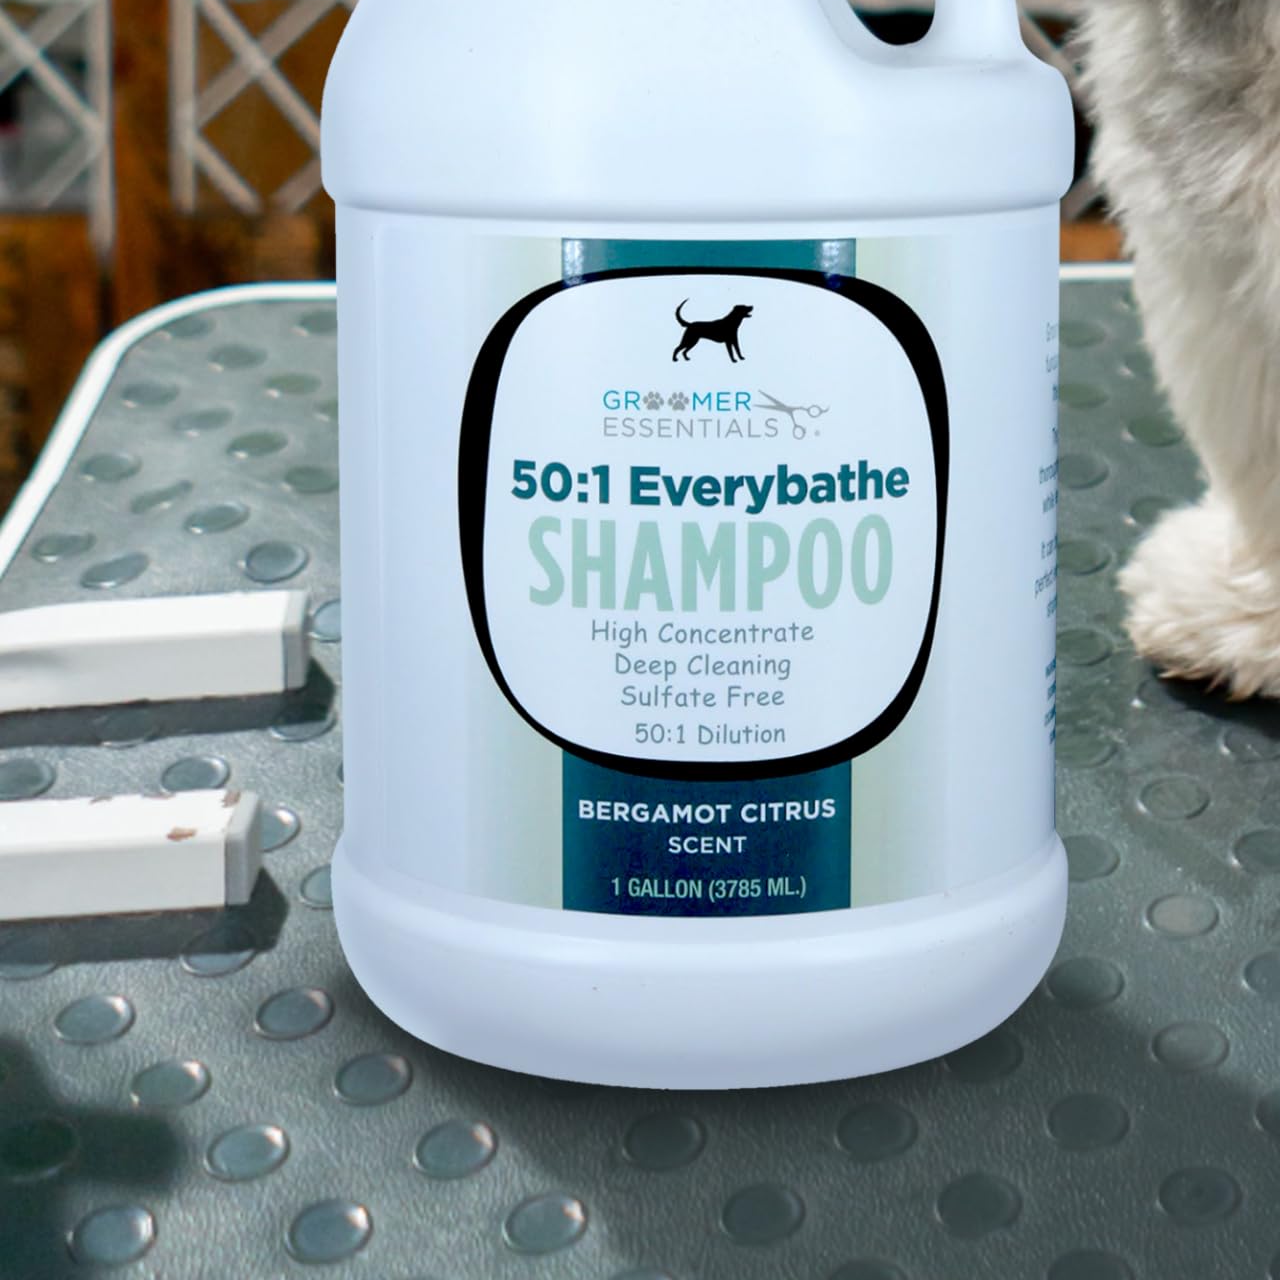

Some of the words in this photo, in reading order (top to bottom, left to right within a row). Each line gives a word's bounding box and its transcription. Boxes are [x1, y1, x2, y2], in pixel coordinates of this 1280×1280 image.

[603, 416, 779, 438] ESSENTIALS
[511, 459, 610, 505] 50:1
[630, 460, 910, 515] Everybathe
[528, 514, 894, 612] SHAMPOO
[591, 620, 648, 649] High
[658, 622, 815, 645] Concentrate
[615, 653, 677, 681] Deep
[687, 653, 792, 680] Cleaning
[620, 686, 717, 709] Sulfate
[727, 687, 786, 708] Free
[634, 723, 687, 745] 50:1
[698, 724, 787, 745] Dilution
[578, 799, 731, 824] BERGAMOT
[740, 798, 837, 822] CITRUS
[668, 835, 747, 854] SCENT
[611, 878, 620, 896] 1
[628, 878, 702, 899] GALLON
[708, 878, 761, 903] (3785
[767, 875, 807, 899] ML.)
